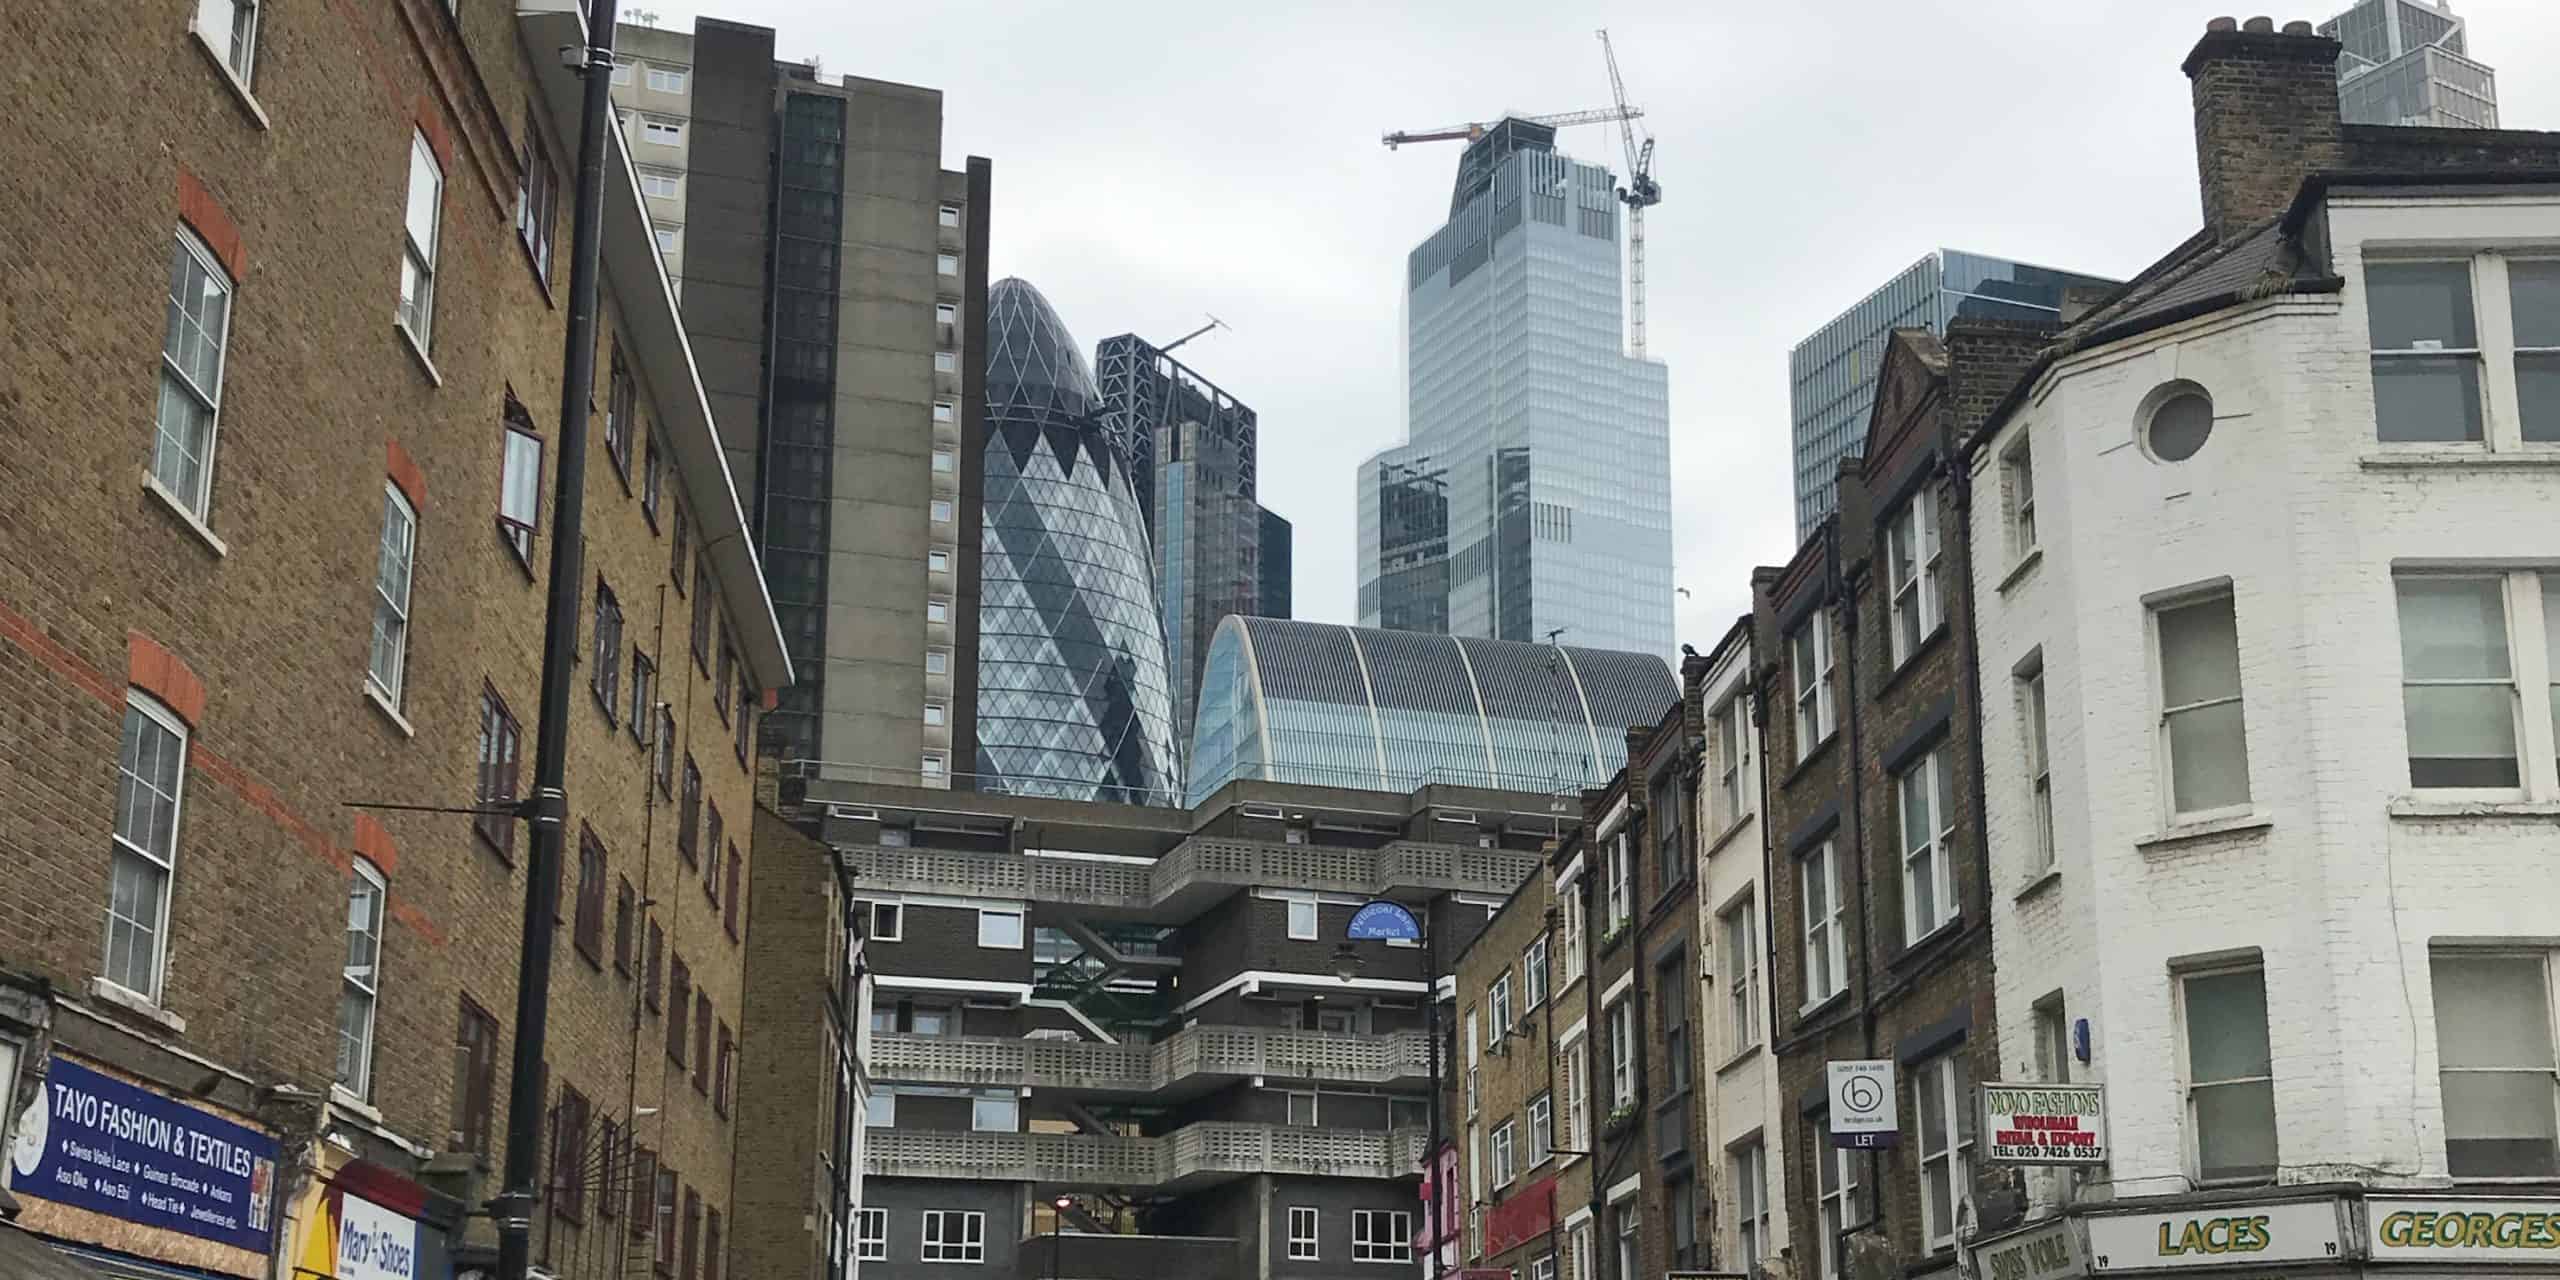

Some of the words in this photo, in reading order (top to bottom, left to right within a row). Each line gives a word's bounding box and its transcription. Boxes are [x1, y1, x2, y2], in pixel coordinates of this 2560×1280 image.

[1367, 927, 1400, 937] Market
[1989, 1090, 2031, 1116] NOVO
[2031, 1090, 2100, 1117] FASHIONS
[55, 1083, 98, 1128] TAYO
[100, 1101, 171, 1153] FASHION
[173, 1126, 185, 1158] &
[189, 1130, 251, 1178] TEXTILES
[2012, 1115, 2079, 1130] WHOLESALE
[1855, 1134, 1875, 1147] LET
[1996, 1130, 2036, 1146] RETAIL
[2038, 1131, 2048, 1146] &
[2050, 1131, 2096, 1147] EXPORT
[69, 1141, 92, 1161] Swiss
[112, 1154, 131, 1173] Lace
[1992, 1146, 2014, 1157] TEL:
[2017, 1146, 2039, 1157] 020
[2042, 1146, 2070, 1158] 7426
[2074, 1147, 2102, 1158] 0537
[56, 1166, 72, 1185] Aso
[72, 1170, 89, 1190] Oke
[171, 1172, 200, 1193] Brocade
[147, 1191, 167, 1211] Head
[168, 1197, 179, 1214] Tie
[2158, 1215, 2272, 1257] LACES
[380, 1231, 411, 1277] Shoes
[2026, 1233, 2071, 1276] VOILE
[2324, 1242, 2337, 1256] 19
[2097, 1255, 2109, 1268] 19
